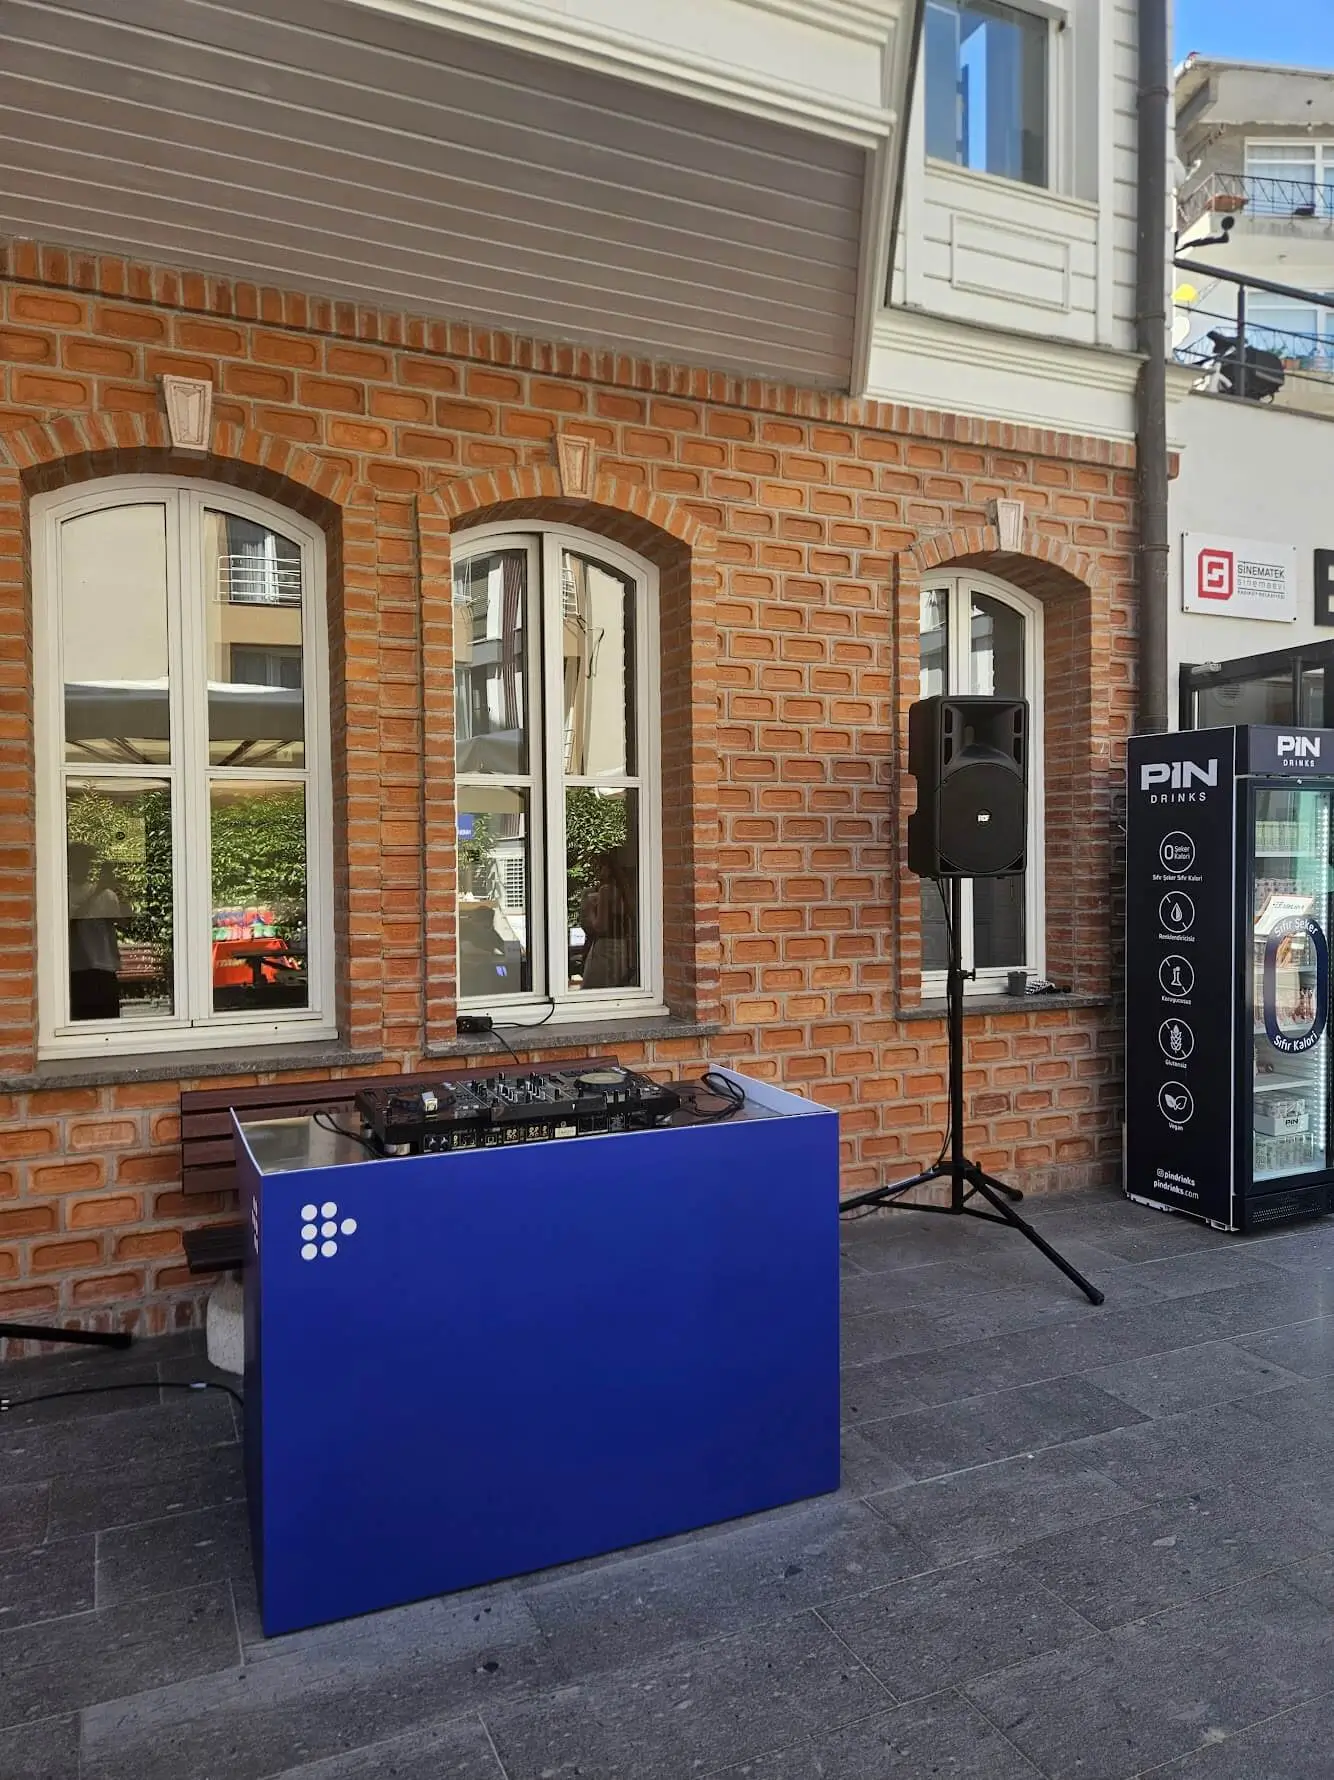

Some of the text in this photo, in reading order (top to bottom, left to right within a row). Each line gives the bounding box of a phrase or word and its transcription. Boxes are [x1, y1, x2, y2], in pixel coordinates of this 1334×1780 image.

[1283, 759, 1315, 767] DRINKS
[1150, 791, 1206, 804] DRINKS
[1293, 1030, 1318, 1051] Kalori
[1168, 1122, 1184, 1131] Vegan
[1153, 1179, 1200, 1200] pindrinks.com
